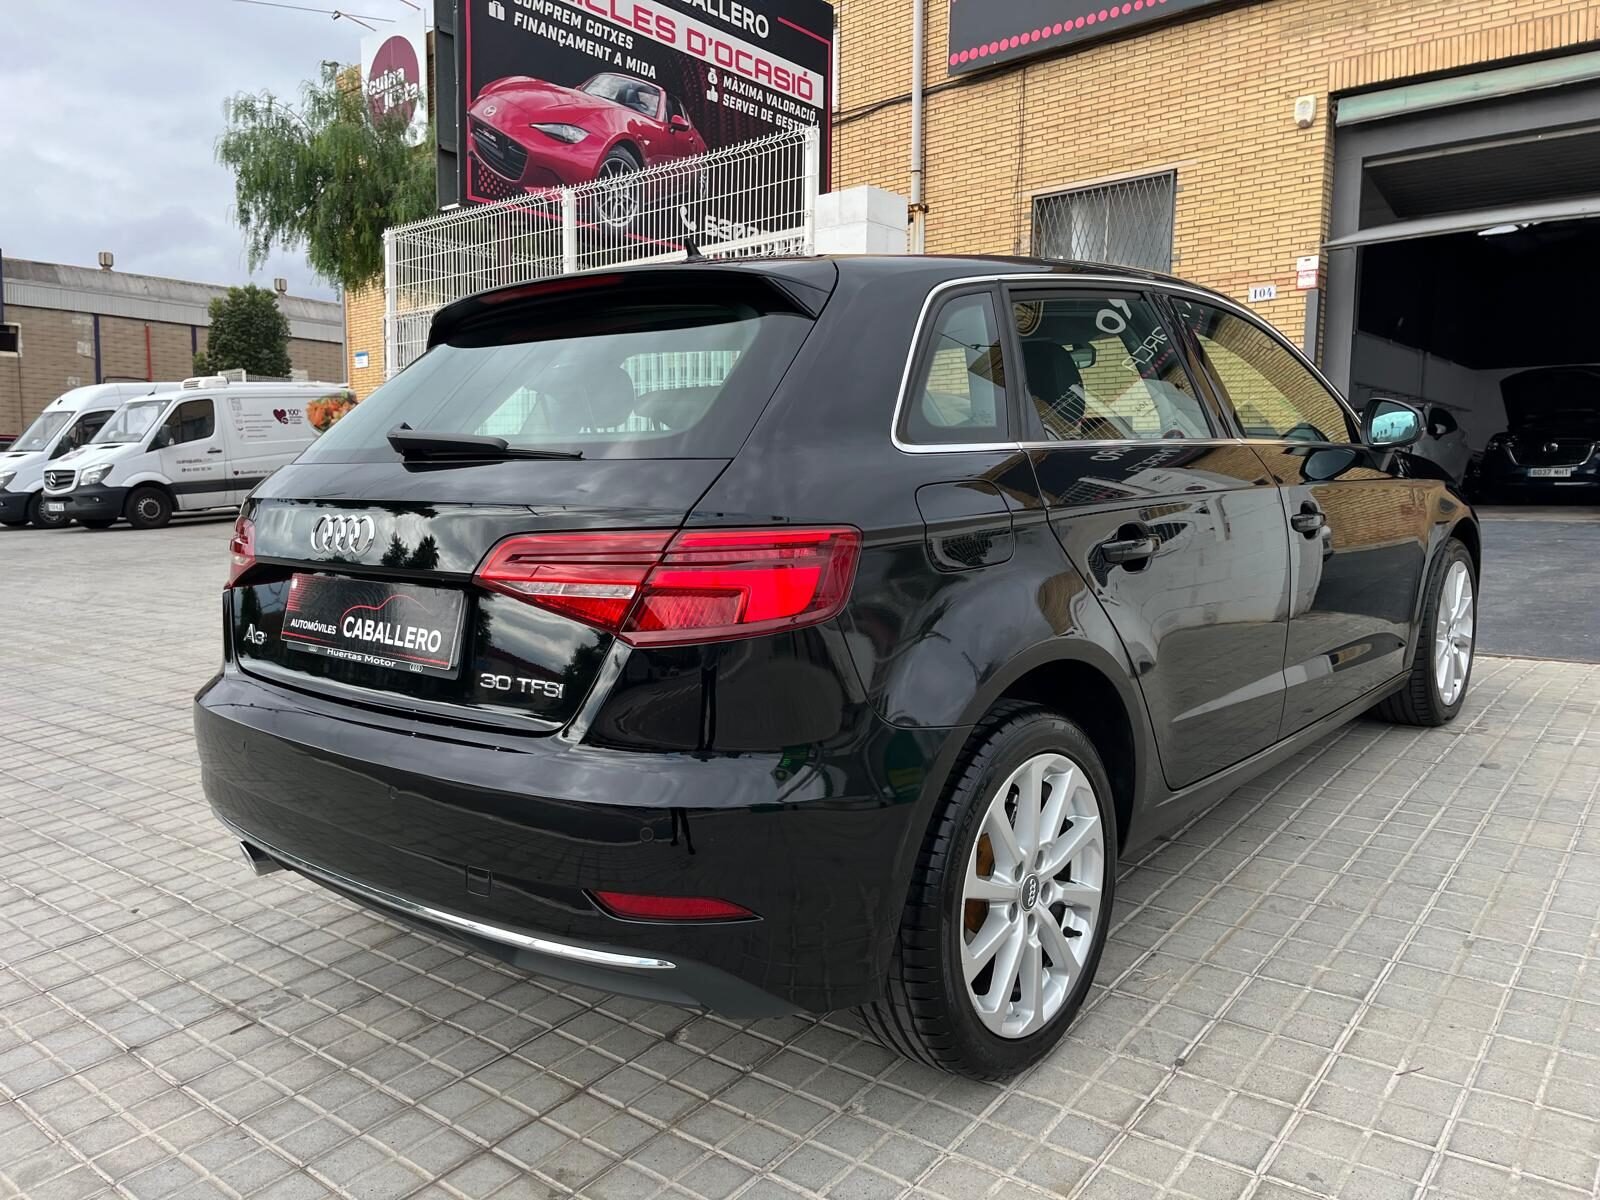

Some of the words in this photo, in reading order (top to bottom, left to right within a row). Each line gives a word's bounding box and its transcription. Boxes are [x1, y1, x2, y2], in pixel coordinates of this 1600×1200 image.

[585, 19, 634, 50] COTXES
[682, 0, 769, 38] LLERO
[514, 11, 612, 61] FINANÇAMENT
[613, 52, 622, 66] A
[626, 56, 656, 79] MIDA
[565, 0, 676, 44] CLES
[686, 27, 813, 101] D'OCASIÓ
[722, 93, 758, 118] SERVEI
[760, 108, 773, 123] DE
[775, 113, 807, 134] GESTO
[723, 75, 764, 103] MÀXIMA
[766, 91, 816, 122] VALORACIÓ
[1253, 287, 1272, 299] 104
[243, 623, 265, 645] A3
[290, 618, 337, 635] AUTOMÓVILES
[342, 616, 442, 653] CABALLERO
[326, 648, 362, 661] Huertas
[364, 655, 397, 668] Motor
[480, 672, 512, 691] 30
[516, 677, 565, 699] TFSI
